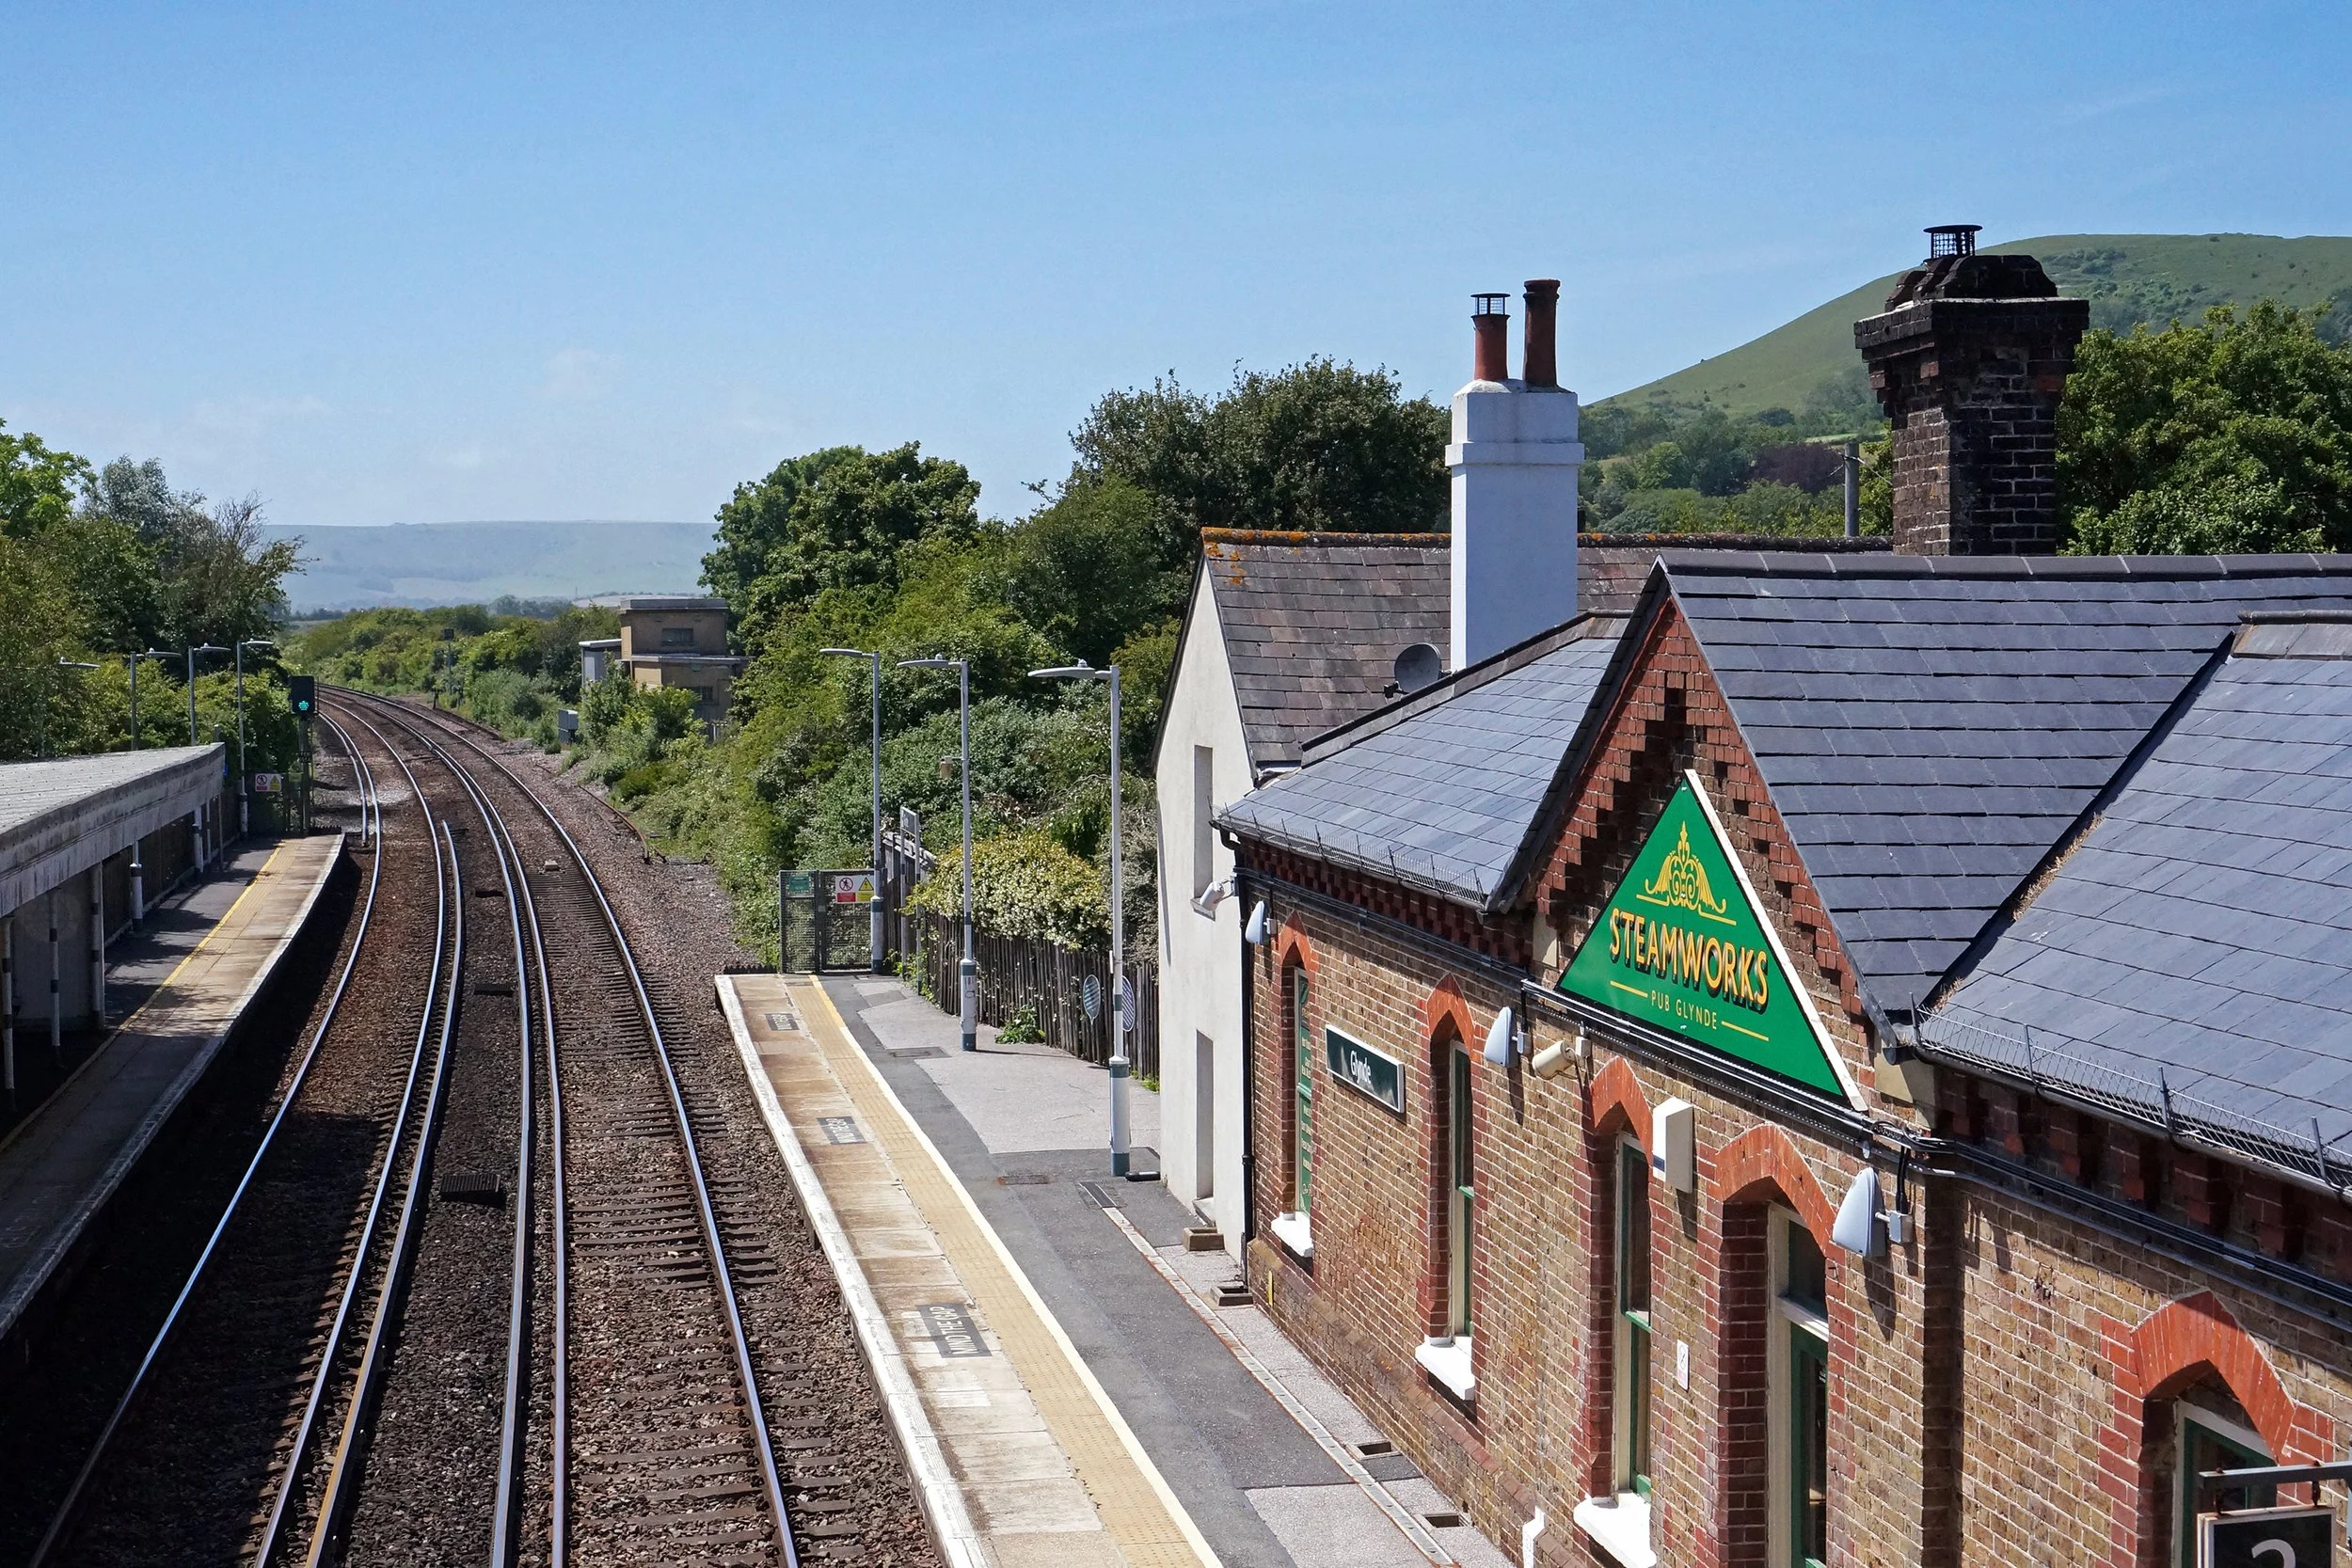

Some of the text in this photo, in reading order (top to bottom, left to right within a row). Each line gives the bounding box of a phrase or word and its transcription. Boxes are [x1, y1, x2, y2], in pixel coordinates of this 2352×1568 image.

[1609, 907, 1769, 1013] STEAMWORKS
[1651, 990, 1718, 1030] PUB GLYNDE
[1350, 1050, 1372, 1085] Glynde
[929, 1307, 979, 1355] MIND THE GAP
